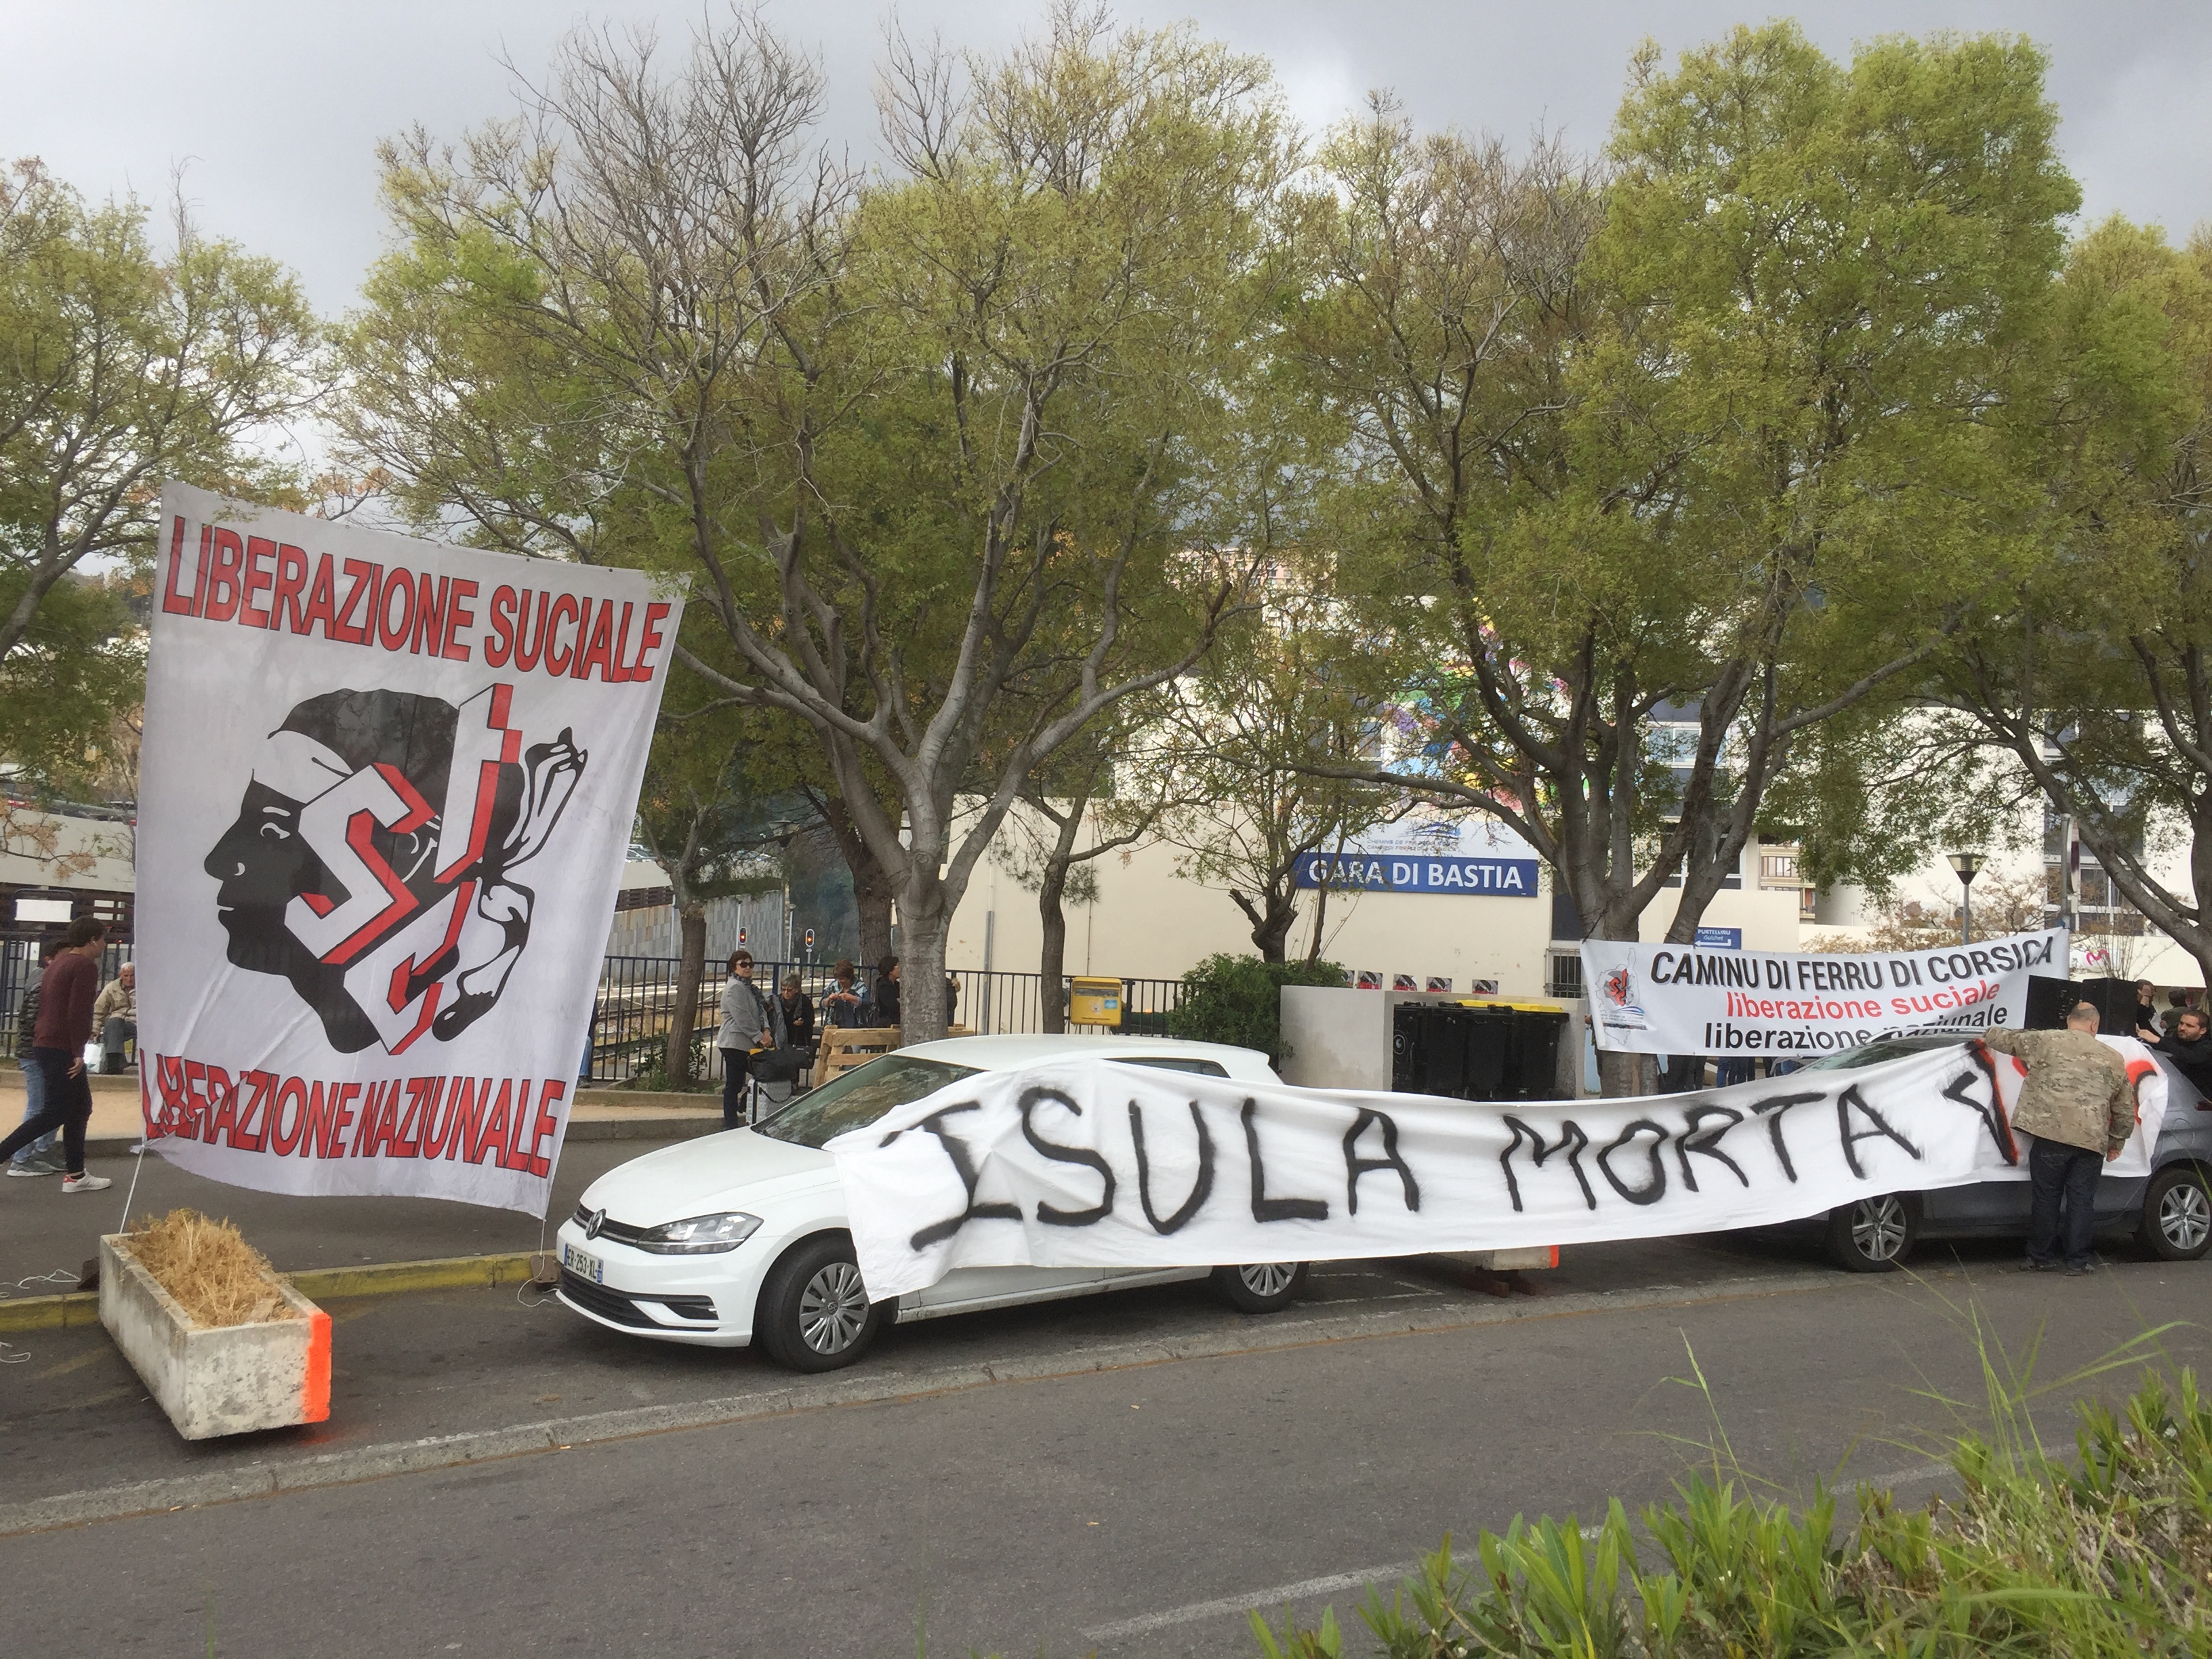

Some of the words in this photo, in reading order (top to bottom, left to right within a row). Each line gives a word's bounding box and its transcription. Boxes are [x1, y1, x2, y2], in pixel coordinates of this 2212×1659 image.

[163, 515, 479, 662] LIBERAZIONE
[485, 584, 671, 684] SUCIALE
[1309, 859, 1384, 884] GARA
[1393, 862, 1418, 885] DI
[1428, 863, 1523, 889] BASTIA
[1650, 951, 1759, 989] CAMINU
[1763, 959, 1793, 991] DI
[1798, 960, 1882, 991] FERRU
[1891, 958, 1925, 988] DI
[1930, 935, 2054, 982] CORSICA
[1727, 991, 1882, 1020] liberazione
[1890, 980, 2001, 1016] suciale
[1704, 1022, 1872, 1050] liberazione
[140, 1048, 360, 1159] LIBERAZIONE
[351, 1076, 566, 1179] NAZIUNALE
[878, 1084, 1421, 1252] ISULA
[1499, 1082, 1922, 1213] MORTA
